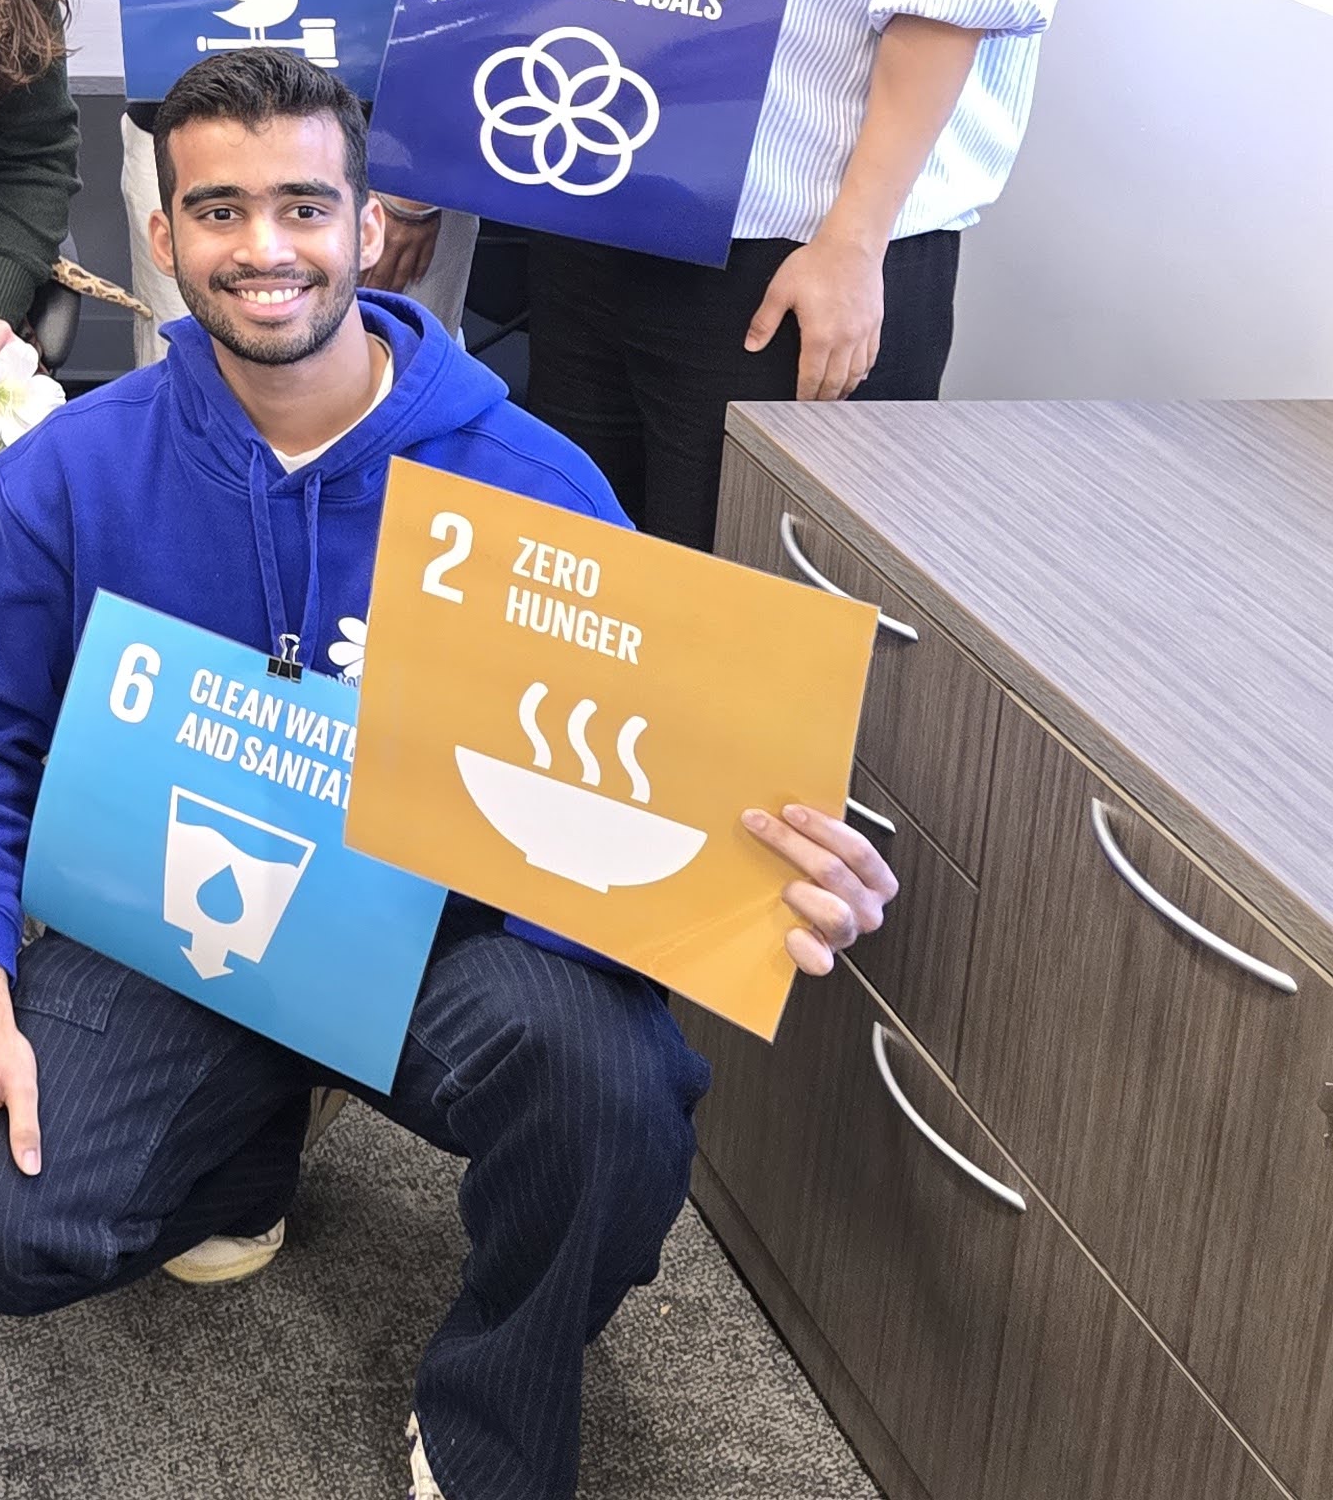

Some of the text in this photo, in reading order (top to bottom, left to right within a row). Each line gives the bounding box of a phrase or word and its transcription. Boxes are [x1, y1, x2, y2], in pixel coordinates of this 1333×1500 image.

[421, 511, 474, 605] 2
[512, 536, 601, 598] ZERO
[505, 585, 643, 666] HUNGER
[109, 643, 162, 724] 6
[190, 668, 358, 764] CLEAN WATE
[175, 711, 352, 810] AND SANITAT
